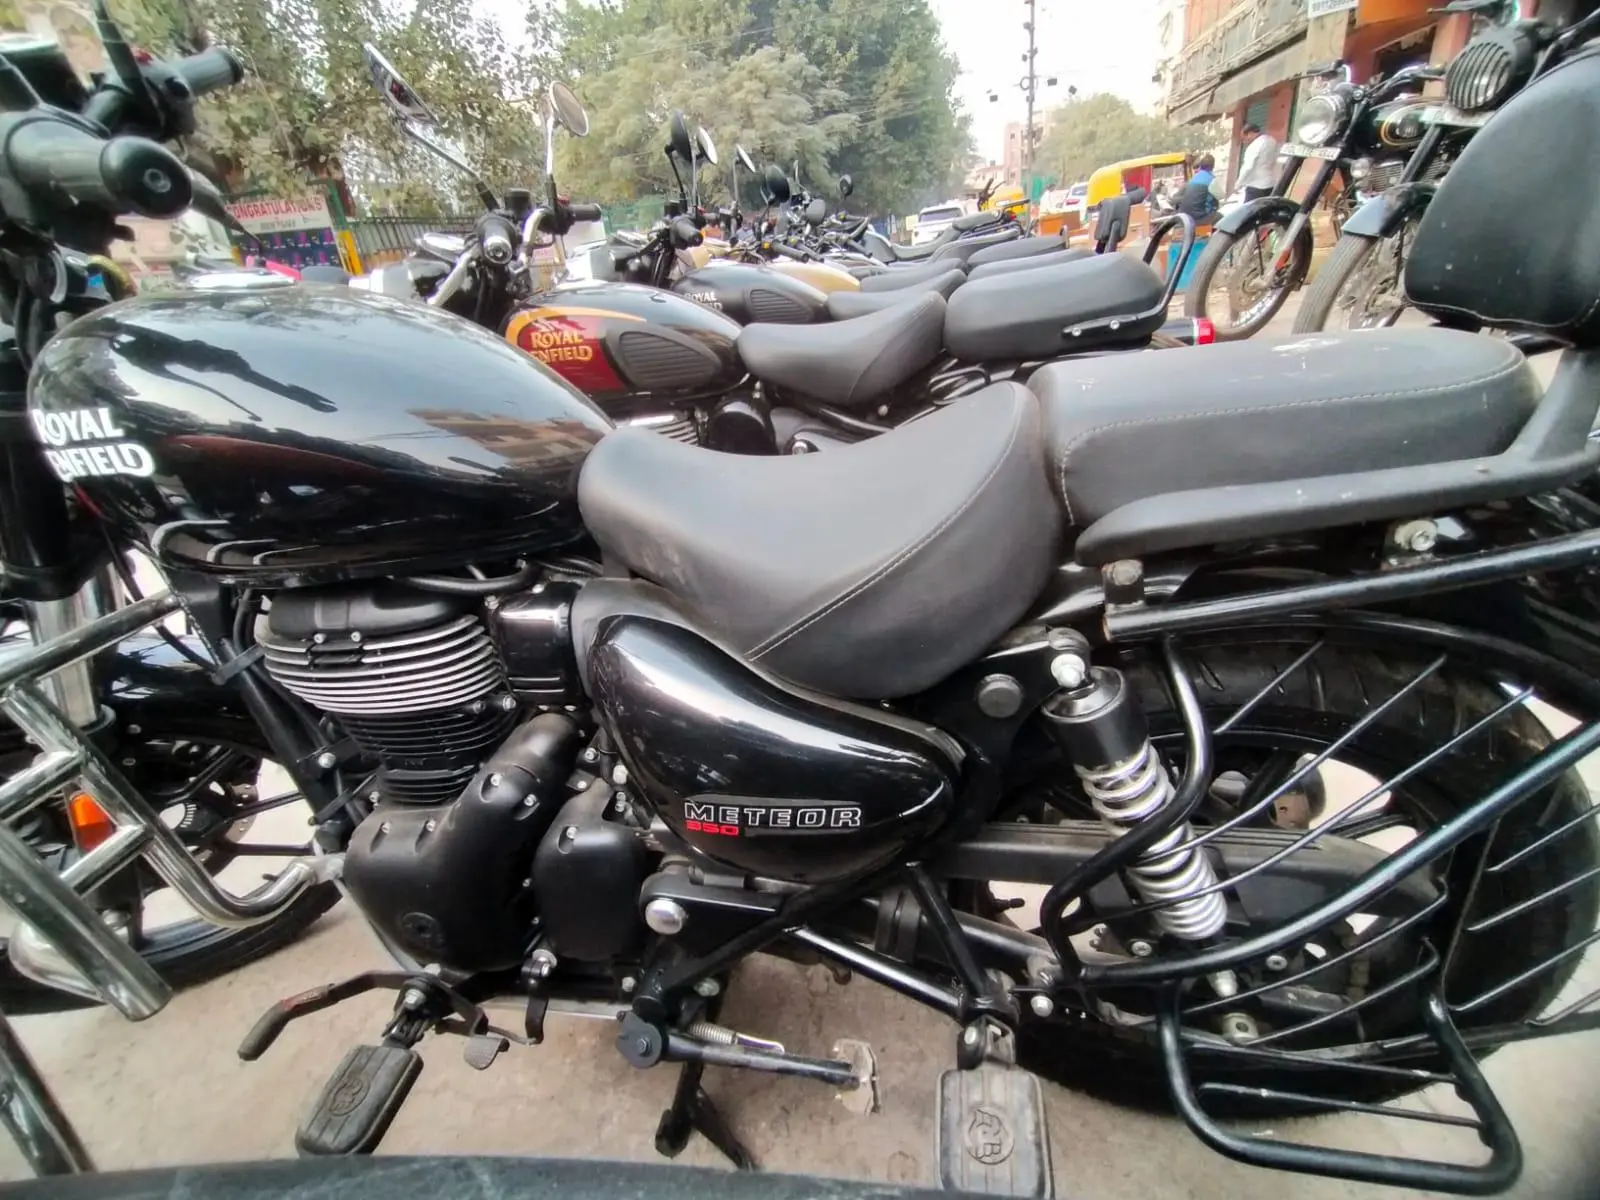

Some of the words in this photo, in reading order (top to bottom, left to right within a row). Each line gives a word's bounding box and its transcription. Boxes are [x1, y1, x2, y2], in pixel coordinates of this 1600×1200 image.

[530, 329, 584, 348] ROYAL
[32, 408, 125, 446] ROYAL
[684, 802, 862, 827] METEOR
[685, 820, 739, 836] 350
